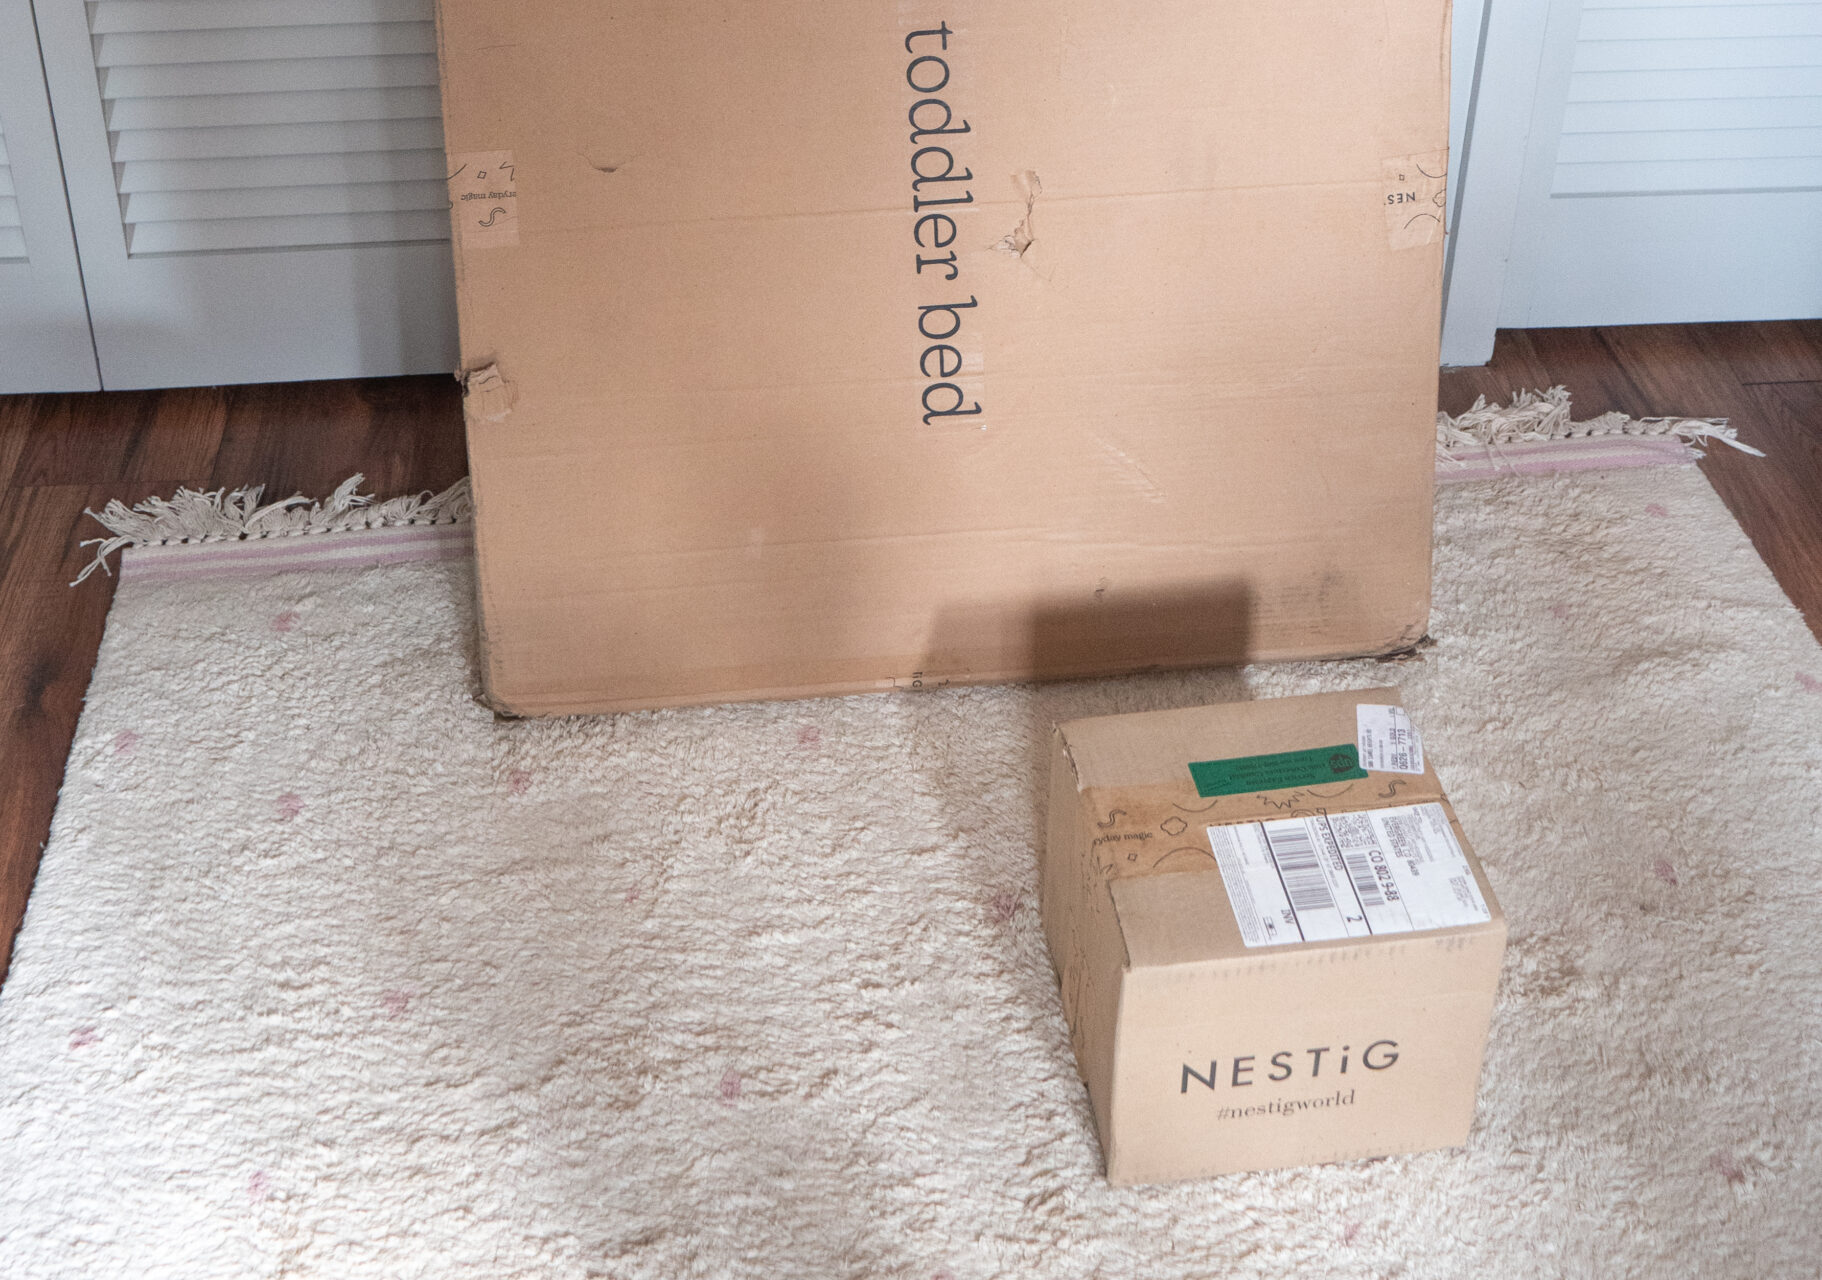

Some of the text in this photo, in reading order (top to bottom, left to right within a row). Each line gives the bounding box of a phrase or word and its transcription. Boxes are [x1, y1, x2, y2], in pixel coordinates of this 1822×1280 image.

[904, 20, 975, 281] toddler
[1387, 191, 1416, 205] NES
[917, 294, 983, 426] bed
[1316, 815, 1329, 831] UPS
[1321, 831, 1343, 871] EXPEDITED
[1368, 849, 1384, 863] CO
[1374, 864, 1391, 881] 802
[1281, 908, 1295, 924] INV
[1346, 914, 1363, 924] 2
[1179, 1038, 1400, 1095] NESTiG
[1215, 1088, 1357, 1122] #nestigworld
